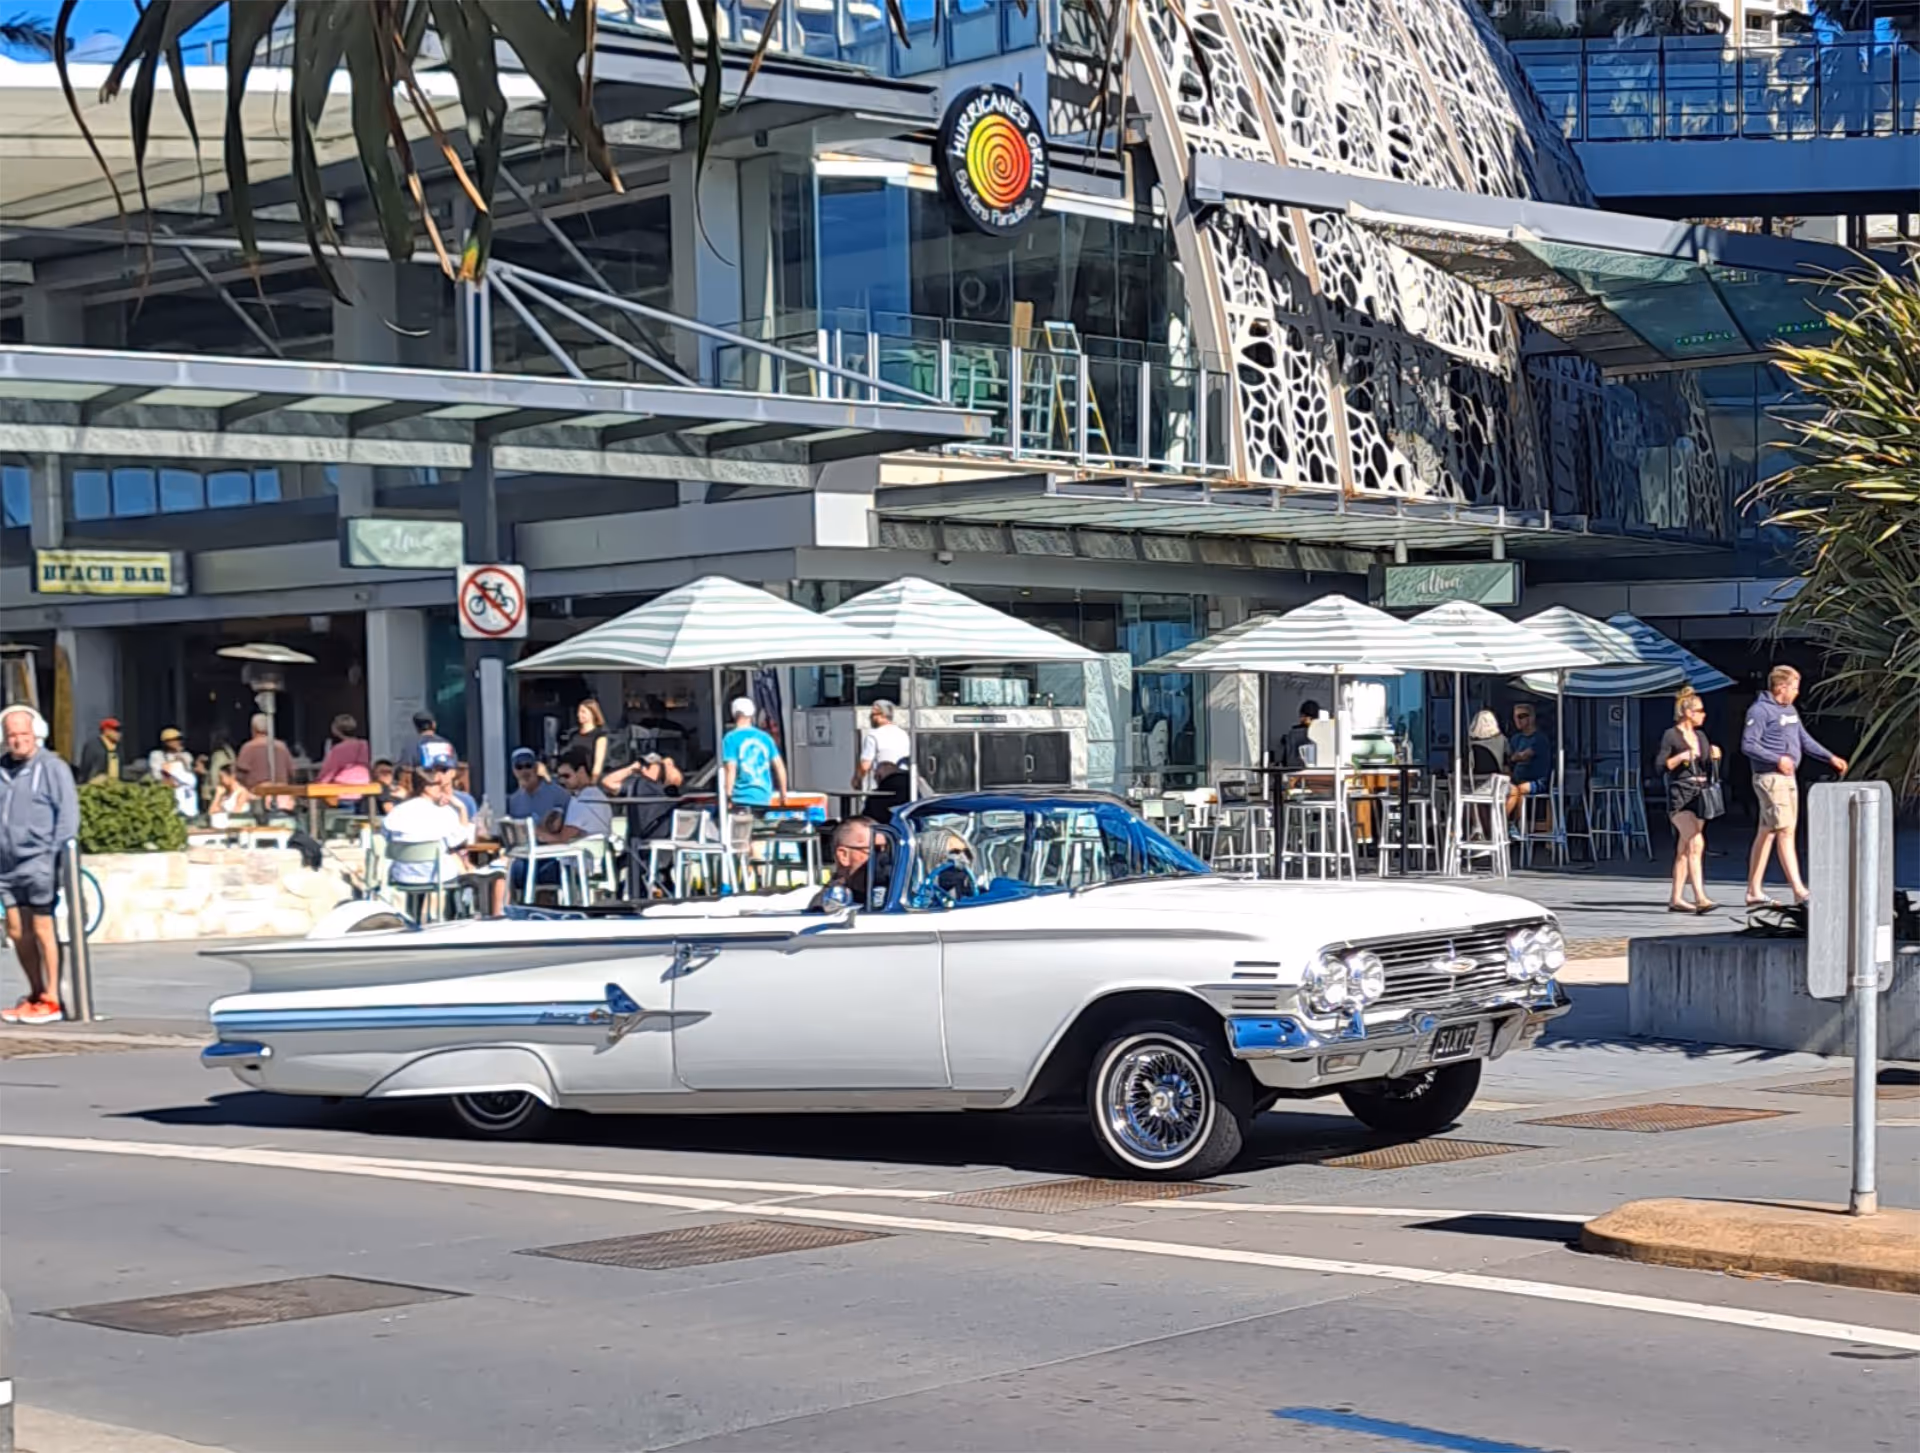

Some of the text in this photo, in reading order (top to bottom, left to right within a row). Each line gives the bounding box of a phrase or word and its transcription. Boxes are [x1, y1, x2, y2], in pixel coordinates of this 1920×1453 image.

[1026, 132, 1045, 190] GRILL
[955, 169, 990, 221] Surfers
[43, 564, 167, 582] BEACH BAR
